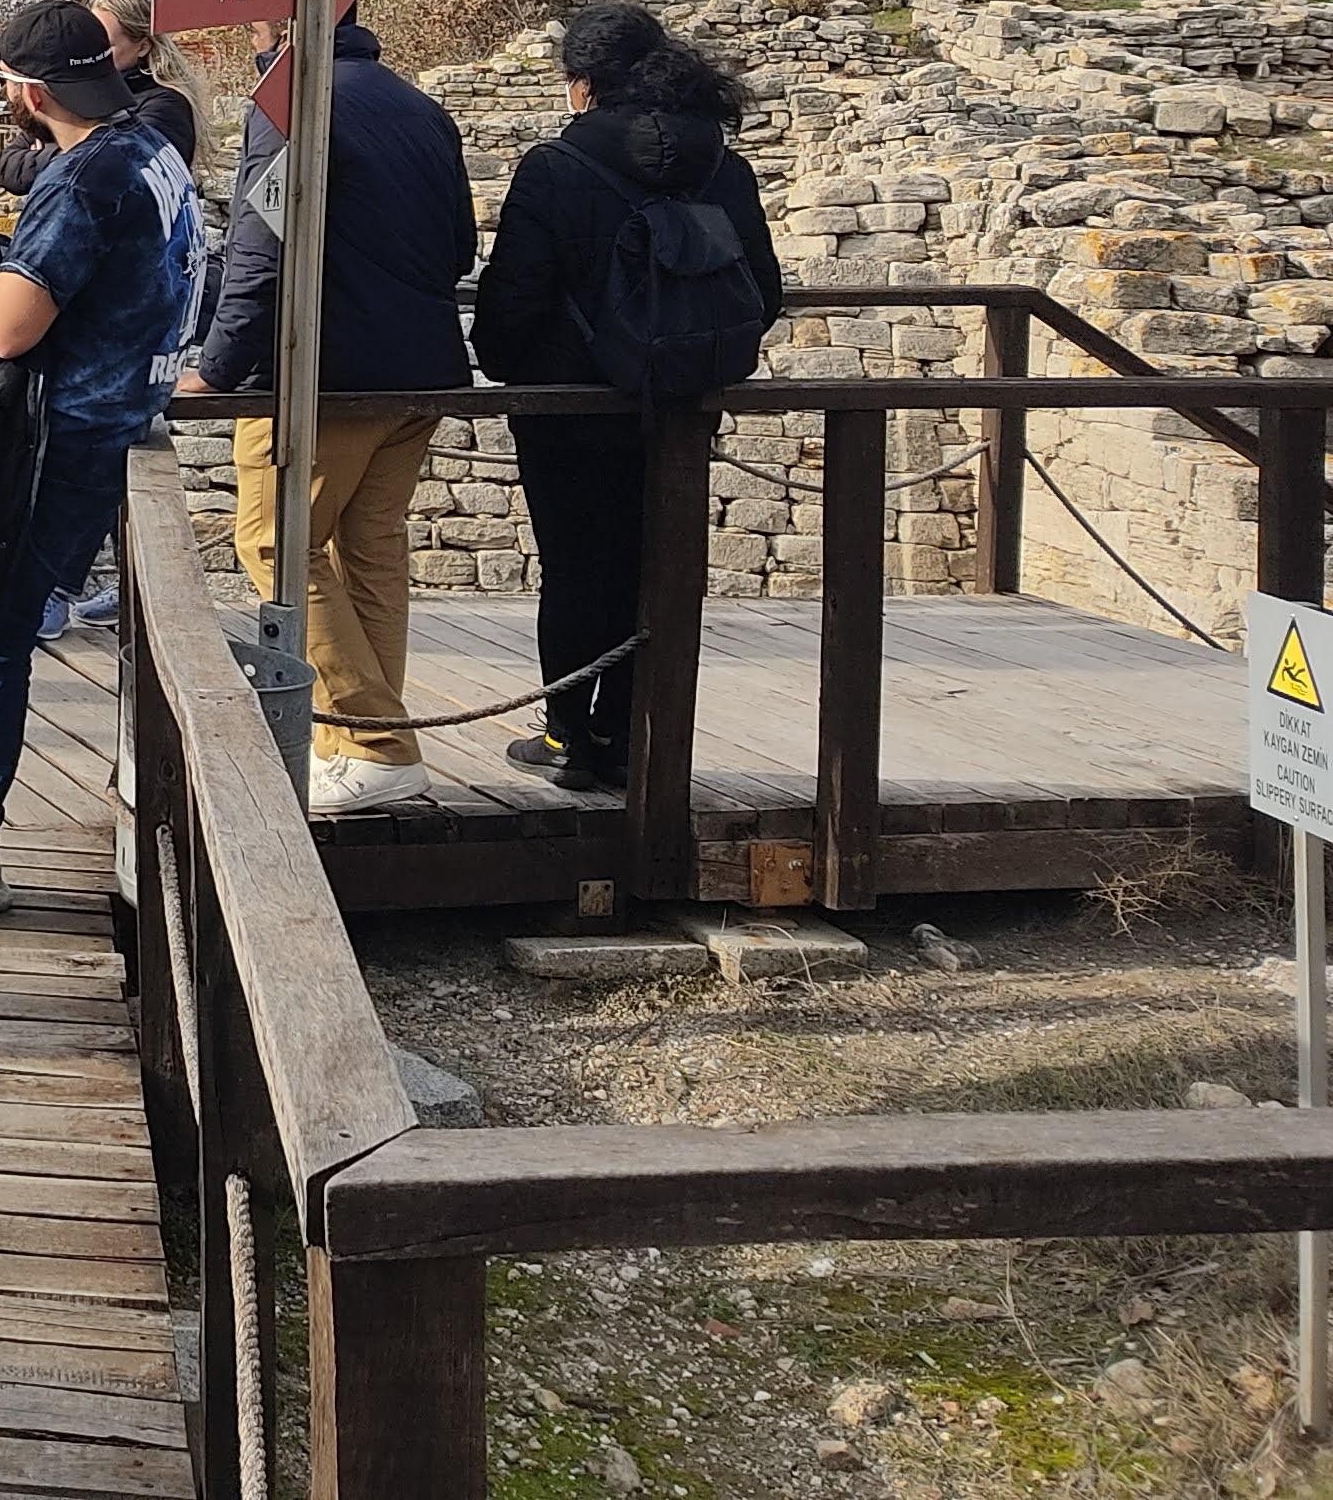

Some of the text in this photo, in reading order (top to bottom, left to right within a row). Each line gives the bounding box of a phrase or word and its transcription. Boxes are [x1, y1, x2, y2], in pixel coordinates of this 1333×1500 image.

[1279, 707, 1312, 739] DİKKAT
[1263, 729, 1329, 771] KAYGAN ZEMİN
[1276, 763, 1316, 795] CAUTION
[1255, 778, 1333, 827] SLIPPERY SURFAC
